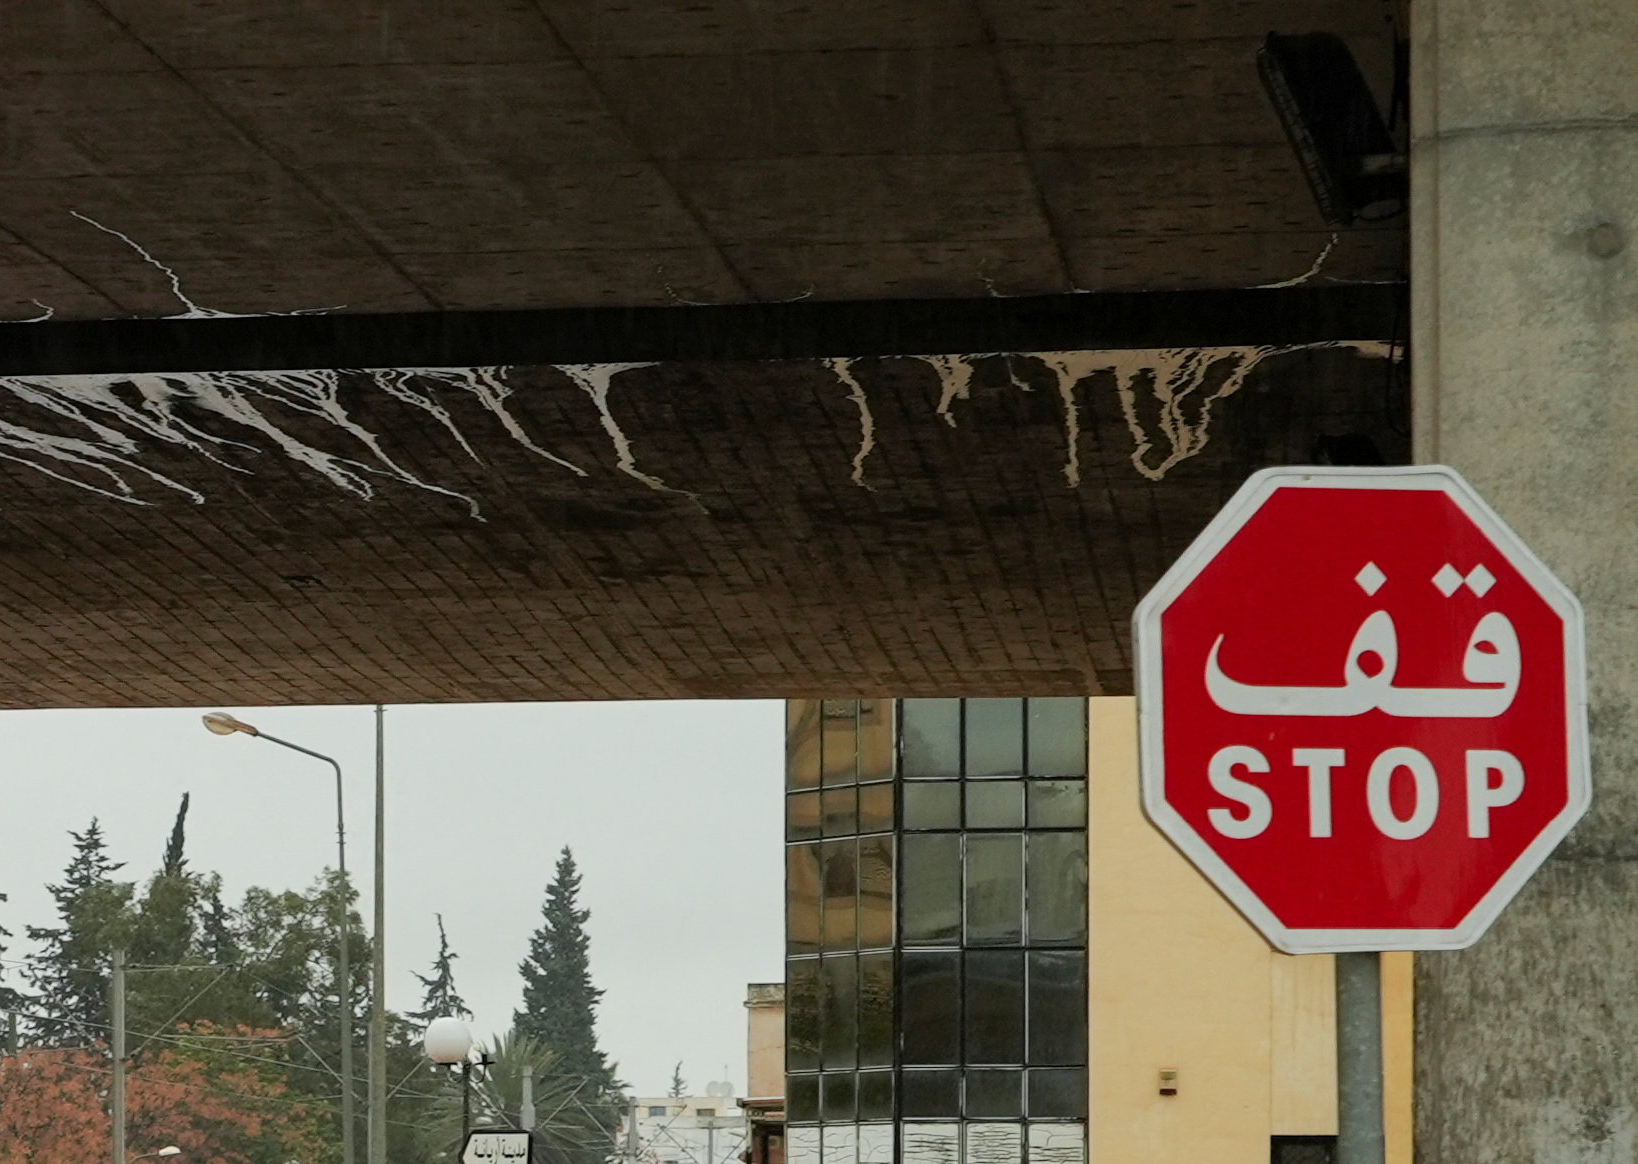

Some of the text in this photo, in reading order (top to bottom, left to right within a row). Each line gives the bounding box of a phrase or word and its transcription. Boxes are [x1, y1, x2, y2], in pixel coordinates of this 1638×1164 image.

[1204, 560, 1522, 718] قف
[1206, 745, 1526, 841] STOP
[502, 1138, 525, 1164] مدينة
